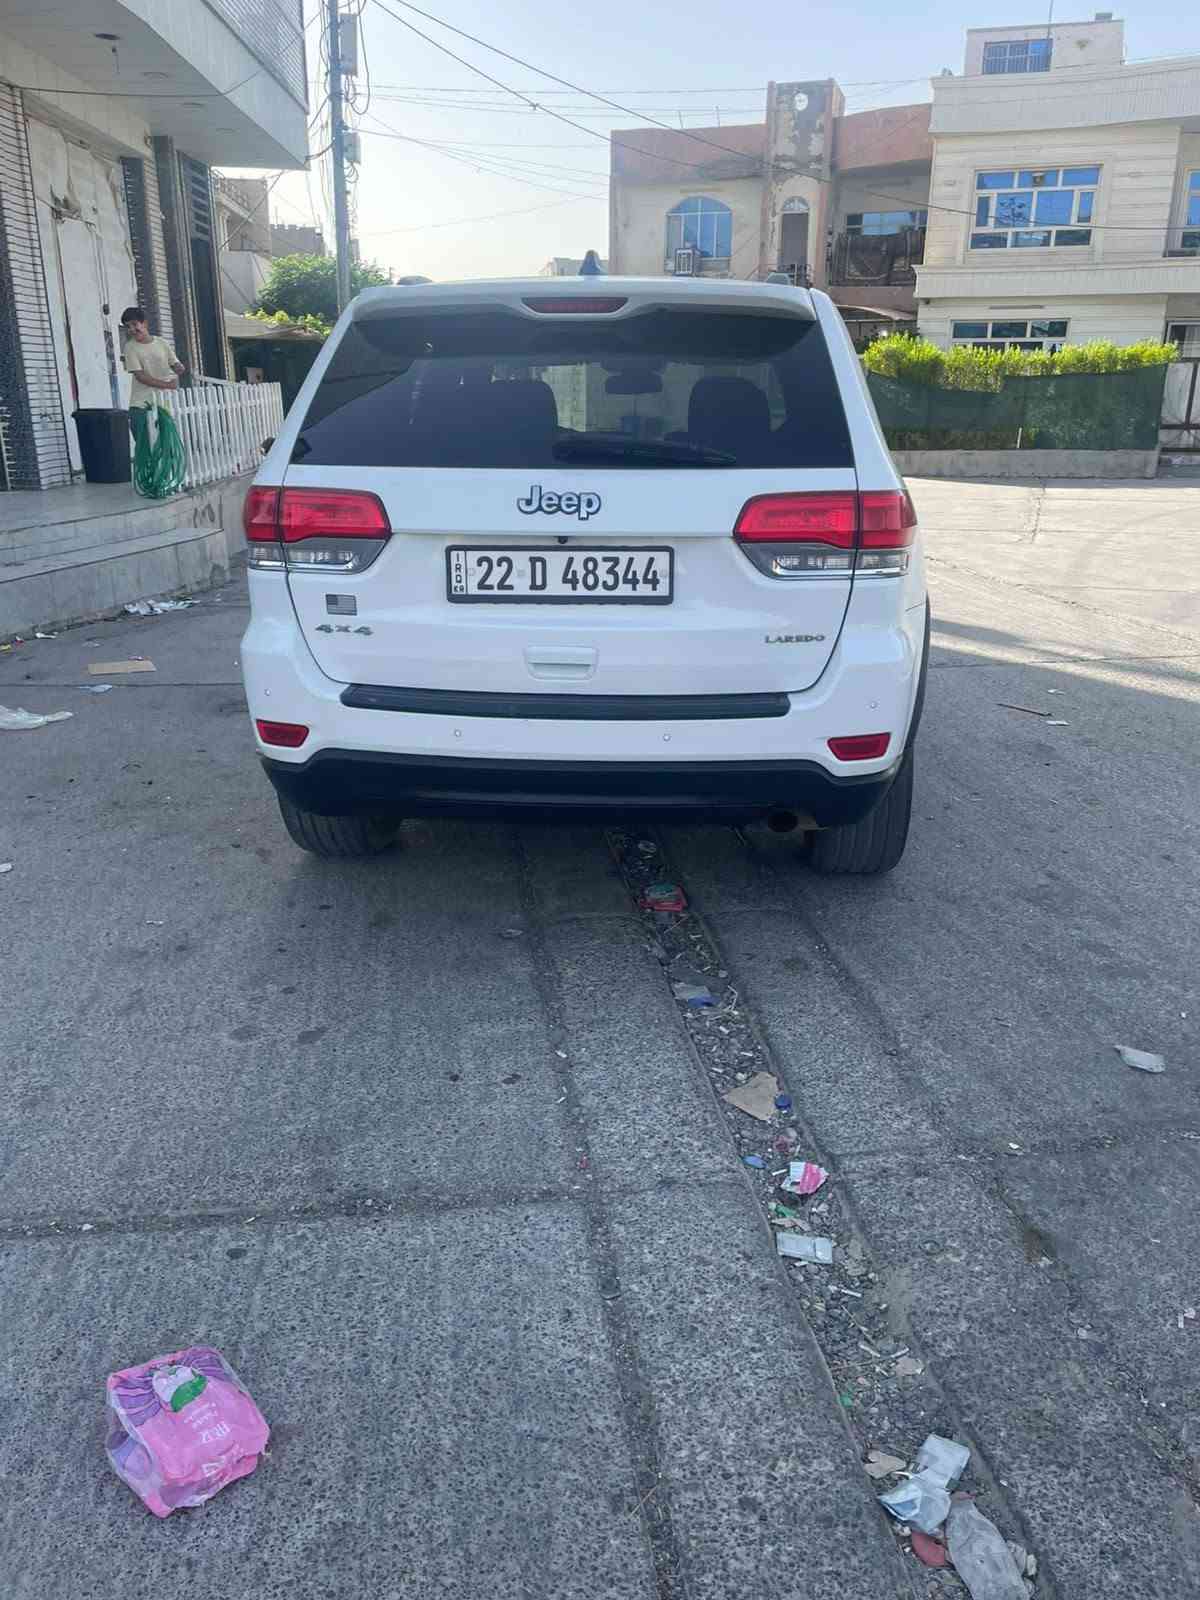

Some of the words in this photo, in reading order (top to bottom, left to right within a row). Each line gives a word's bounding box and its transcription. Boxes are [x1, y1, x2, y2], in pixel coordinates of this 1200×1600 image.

[517, 485, 601, 520] Jeep
[476, 556, 514, 591] 22
[528, 556, 547, 591] D
[562, 556, 660, 591] 48344
